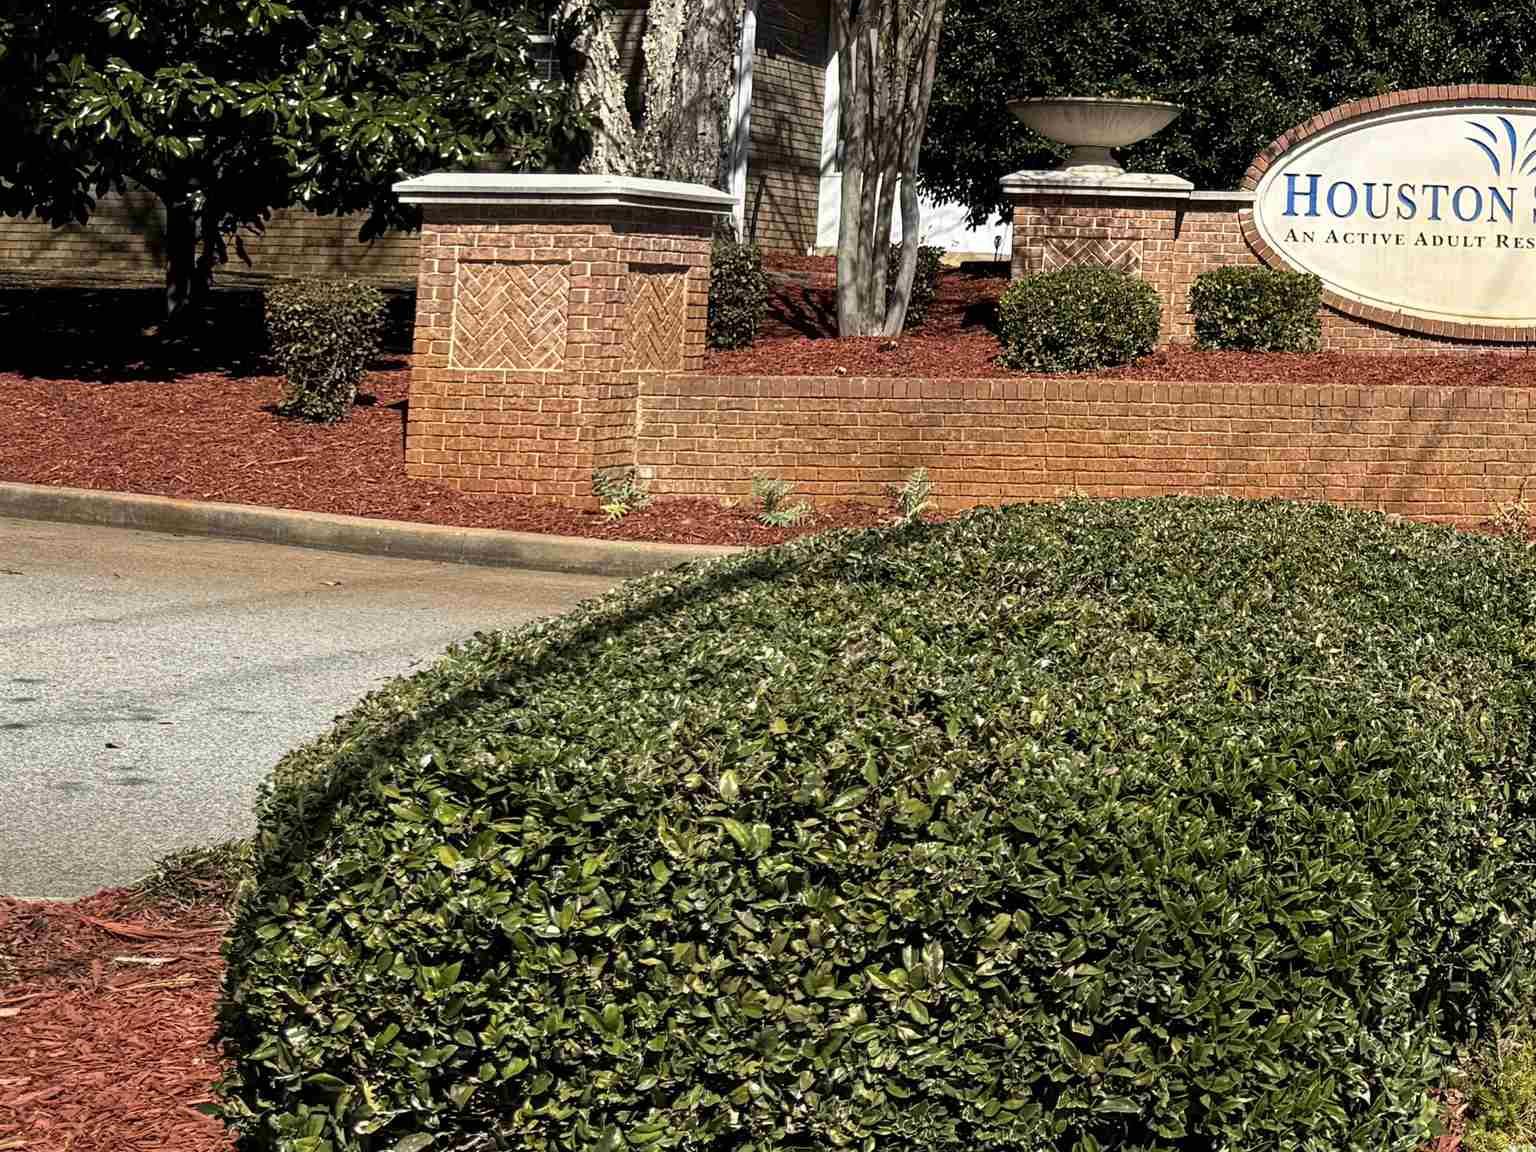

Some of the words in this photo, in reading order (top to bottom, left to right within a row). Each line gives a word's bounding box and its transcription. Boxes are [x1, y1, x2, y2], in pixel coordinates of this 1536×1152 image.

[1281, 172, 1518, 224] HOUSTON
[1284, 228, 1315, 243] AN
[1325, 229, 1406, 246] ACTIVE
[1414, 232, 1487, 248] ADULT
